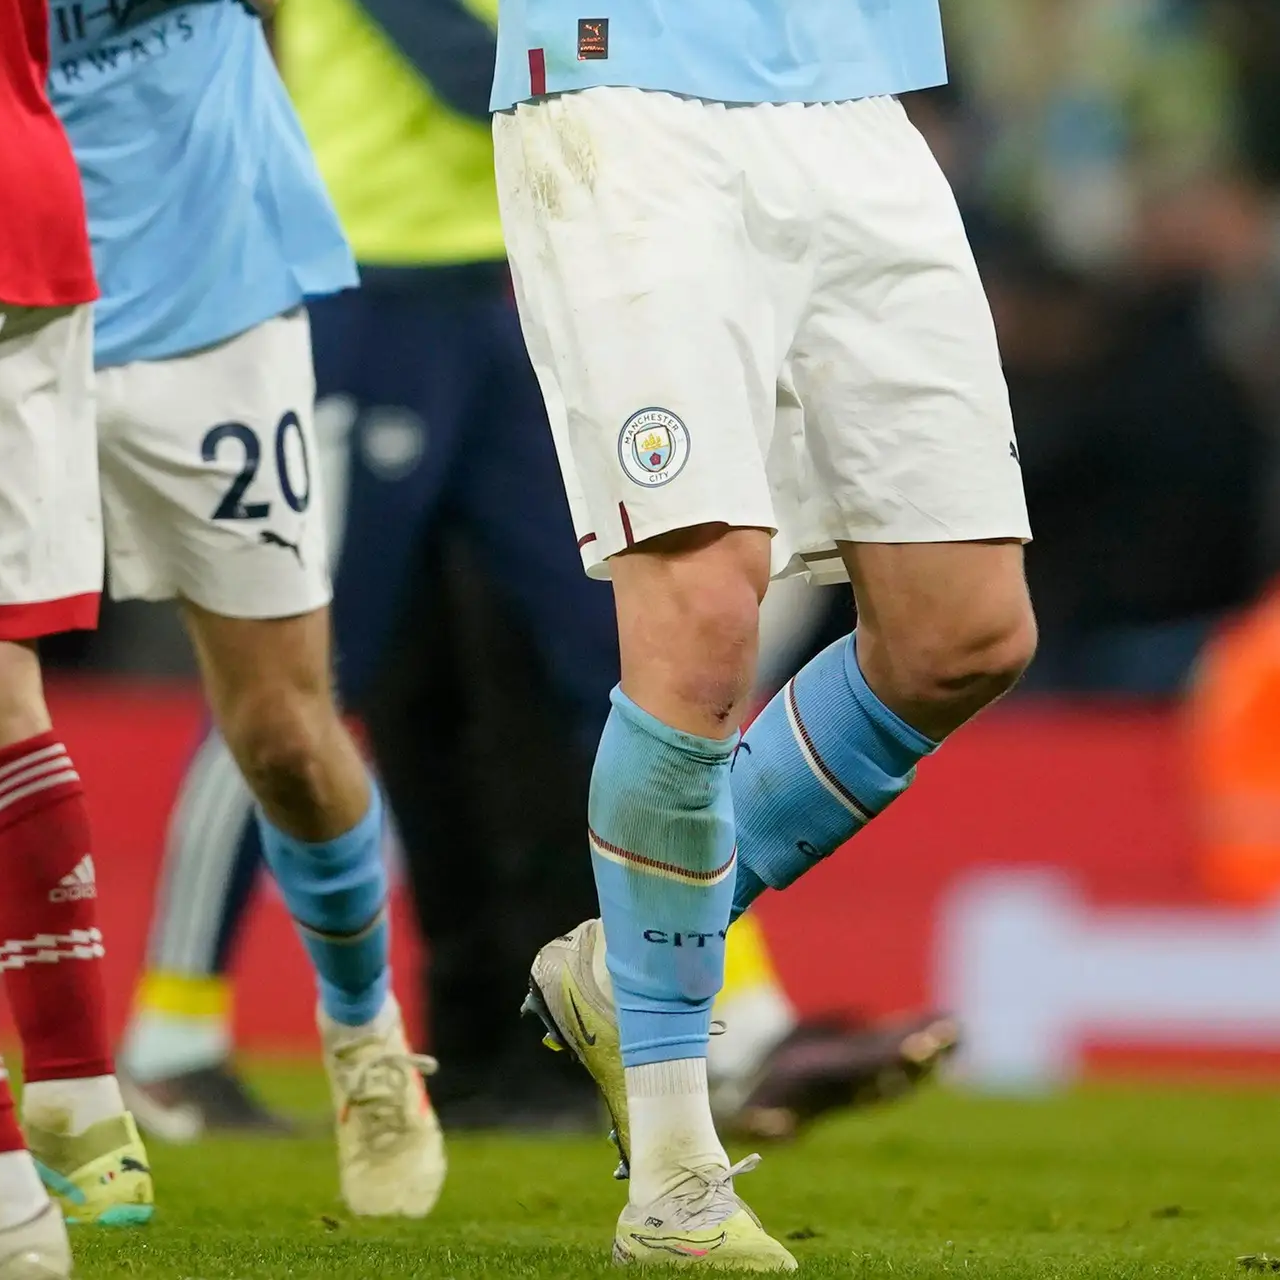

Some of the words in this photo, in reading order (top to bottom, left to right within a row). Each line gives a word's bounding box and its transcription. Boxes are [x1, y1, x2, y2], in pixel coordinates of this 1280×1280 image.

[60, 13, 194, 85] RWAYS
[624, 413, 680, 445] MANCHESTER
[201, 409, 310, 520] 20
[649, 471, 670, 483] CITY
[643, 929, 726, 948] CIT
